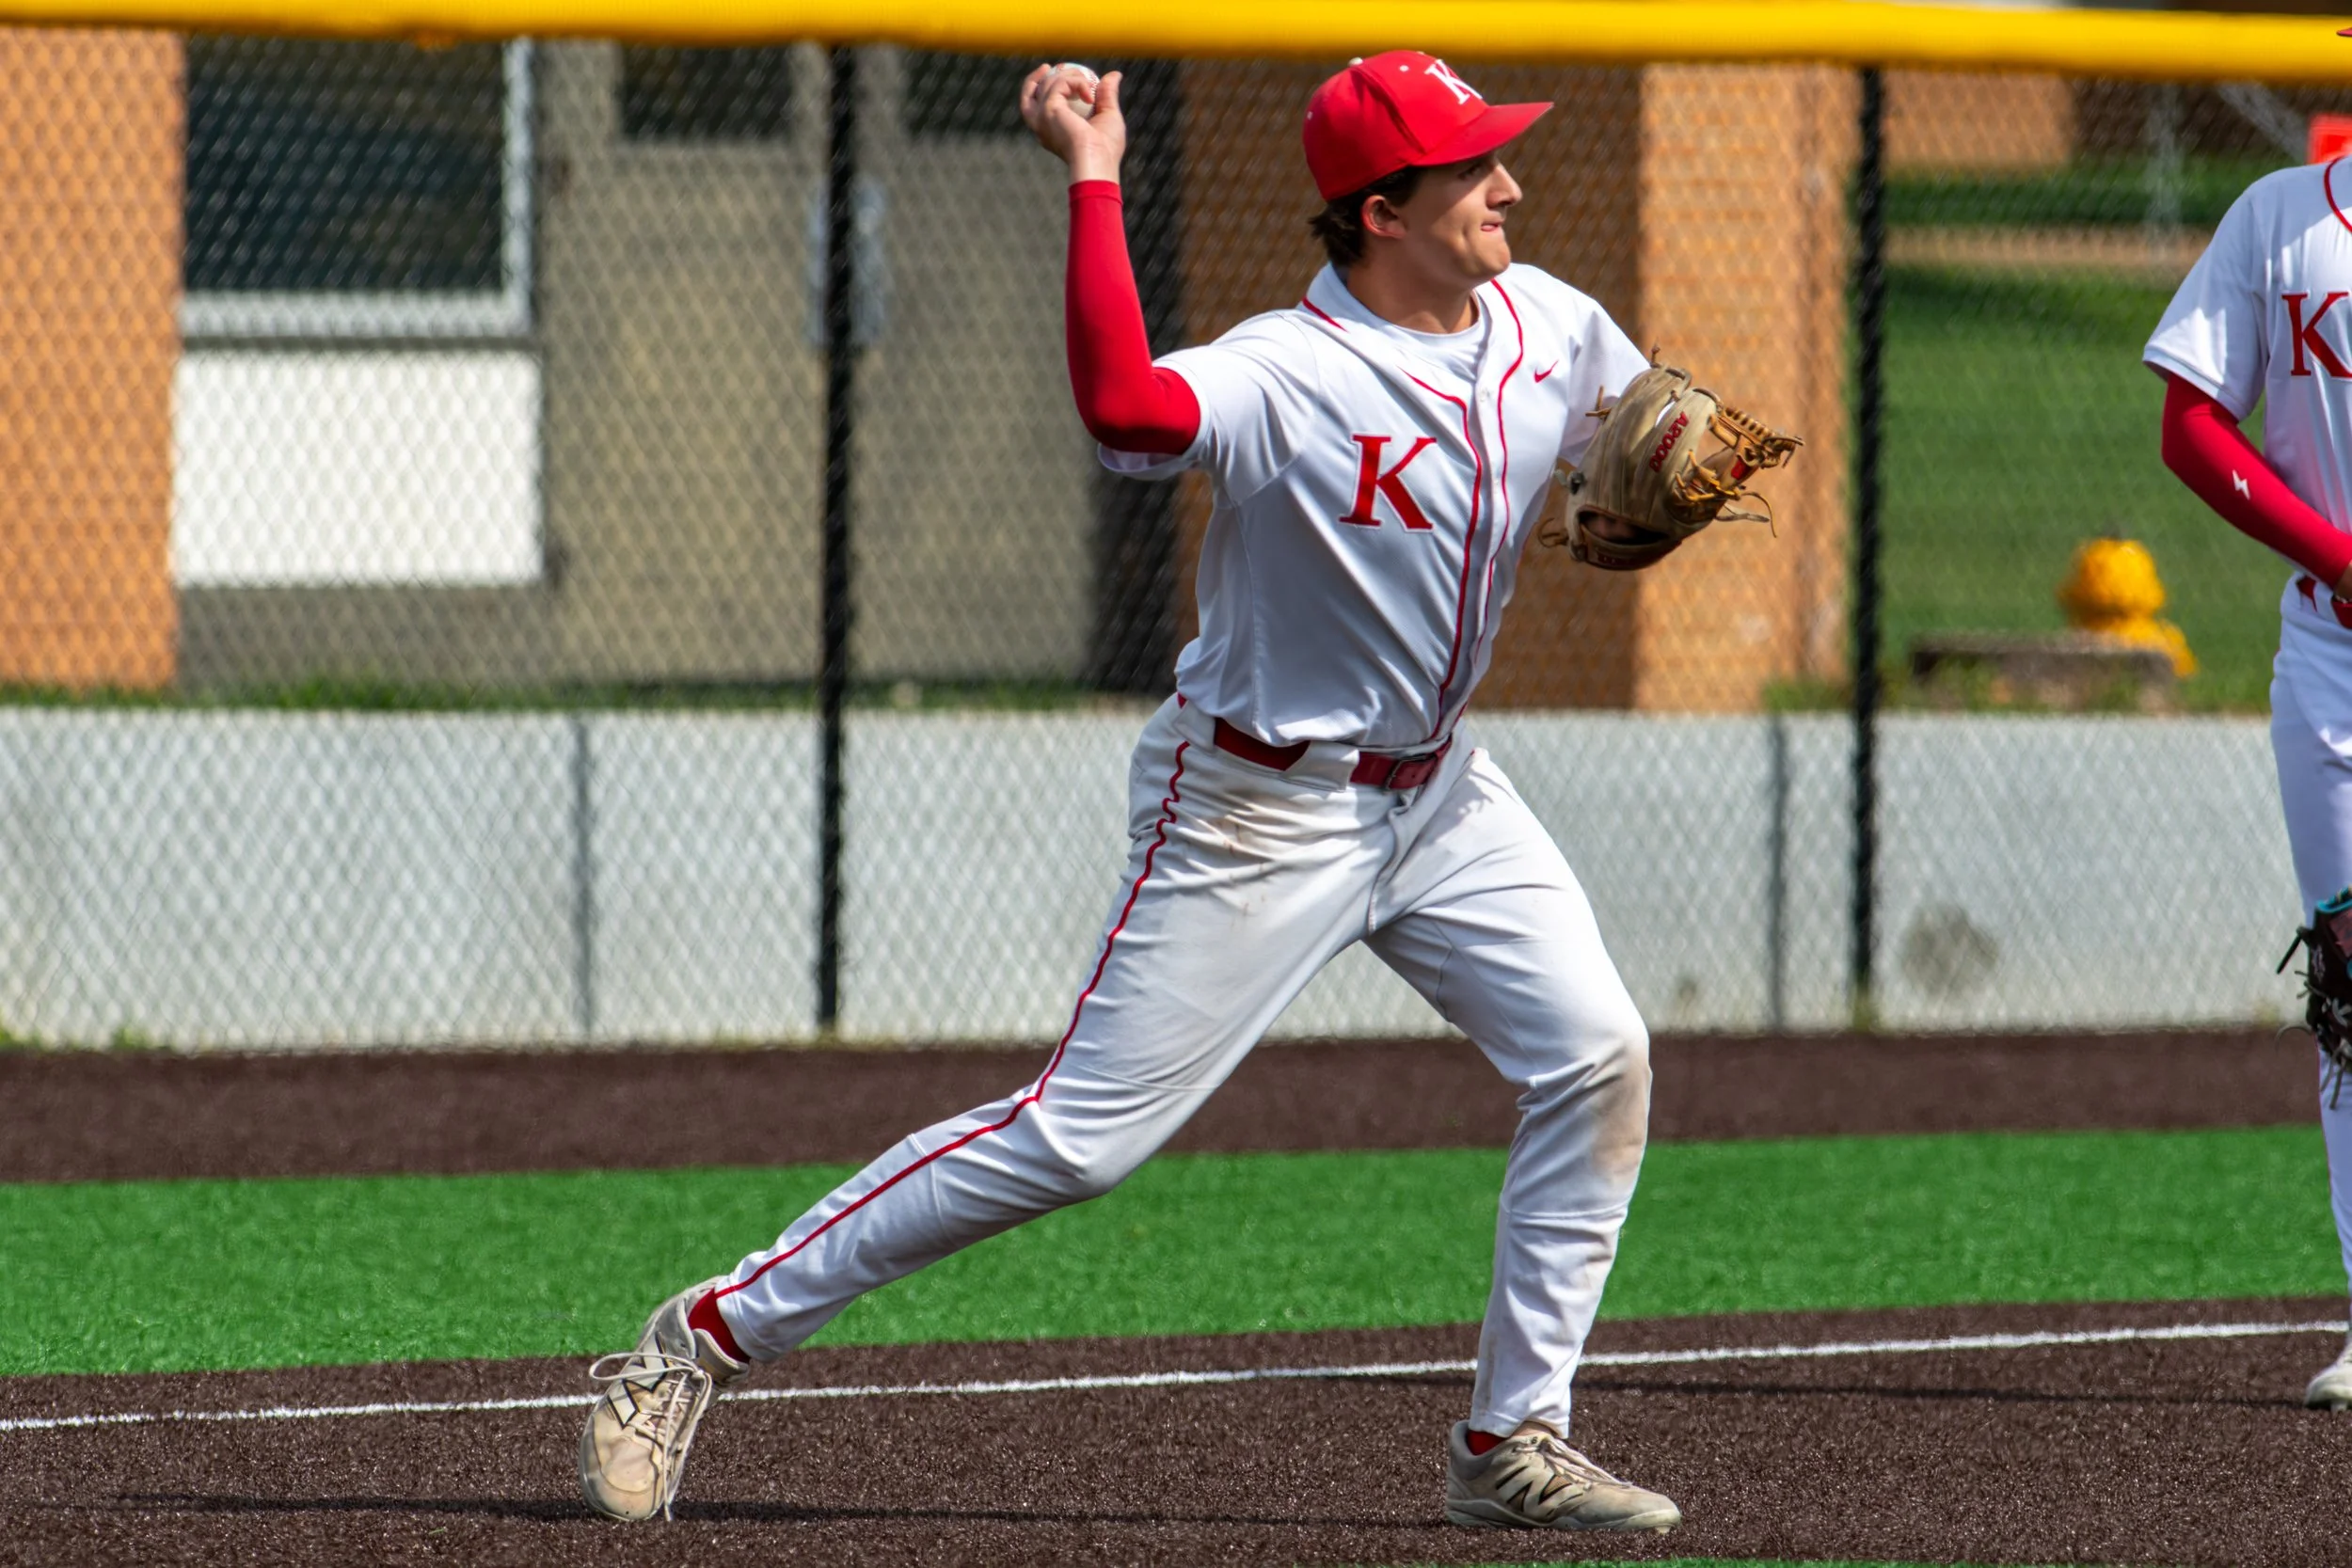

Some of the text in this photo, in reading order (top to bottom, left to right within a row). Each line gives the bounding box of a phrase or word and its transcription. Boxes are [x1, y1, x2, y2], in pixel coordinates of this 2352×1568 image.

[1424, 59, 1484, 104] K
[2281, 292, 2352, 379] K
[1648, 411, 1690, 473] A2000
[1339, 435, 1438, 531] K
